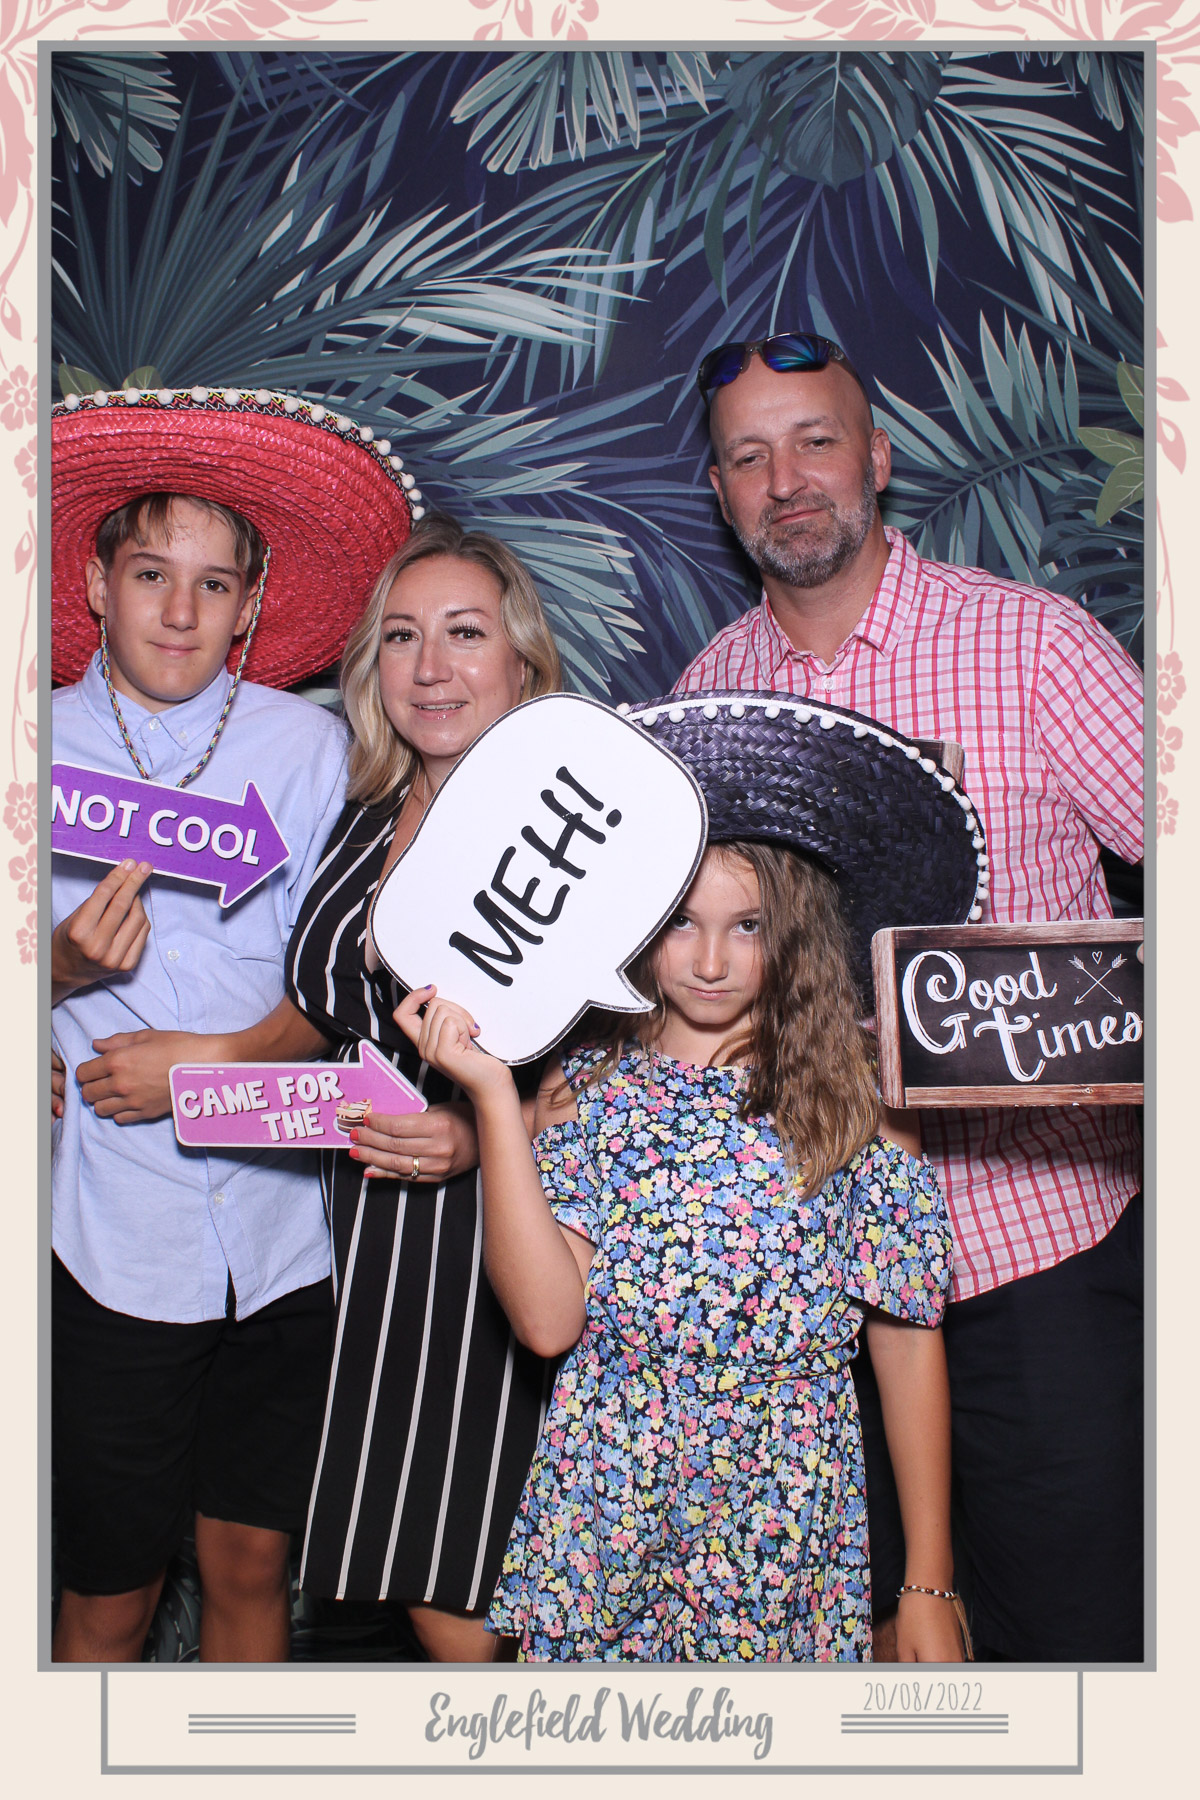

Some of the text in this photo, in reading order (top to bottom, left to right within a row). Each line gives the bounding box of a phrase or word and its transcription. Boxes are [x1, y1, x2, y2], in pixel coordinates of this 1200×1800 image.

[52, 784, 261, 866] NOT COOL
[449, 766, 622, 986] MEH!
[902, 950, 1058, 1055] Good
[179, 1070, 344, 1120] CAME FOR
[261, 1106, 325, 1142] THE
